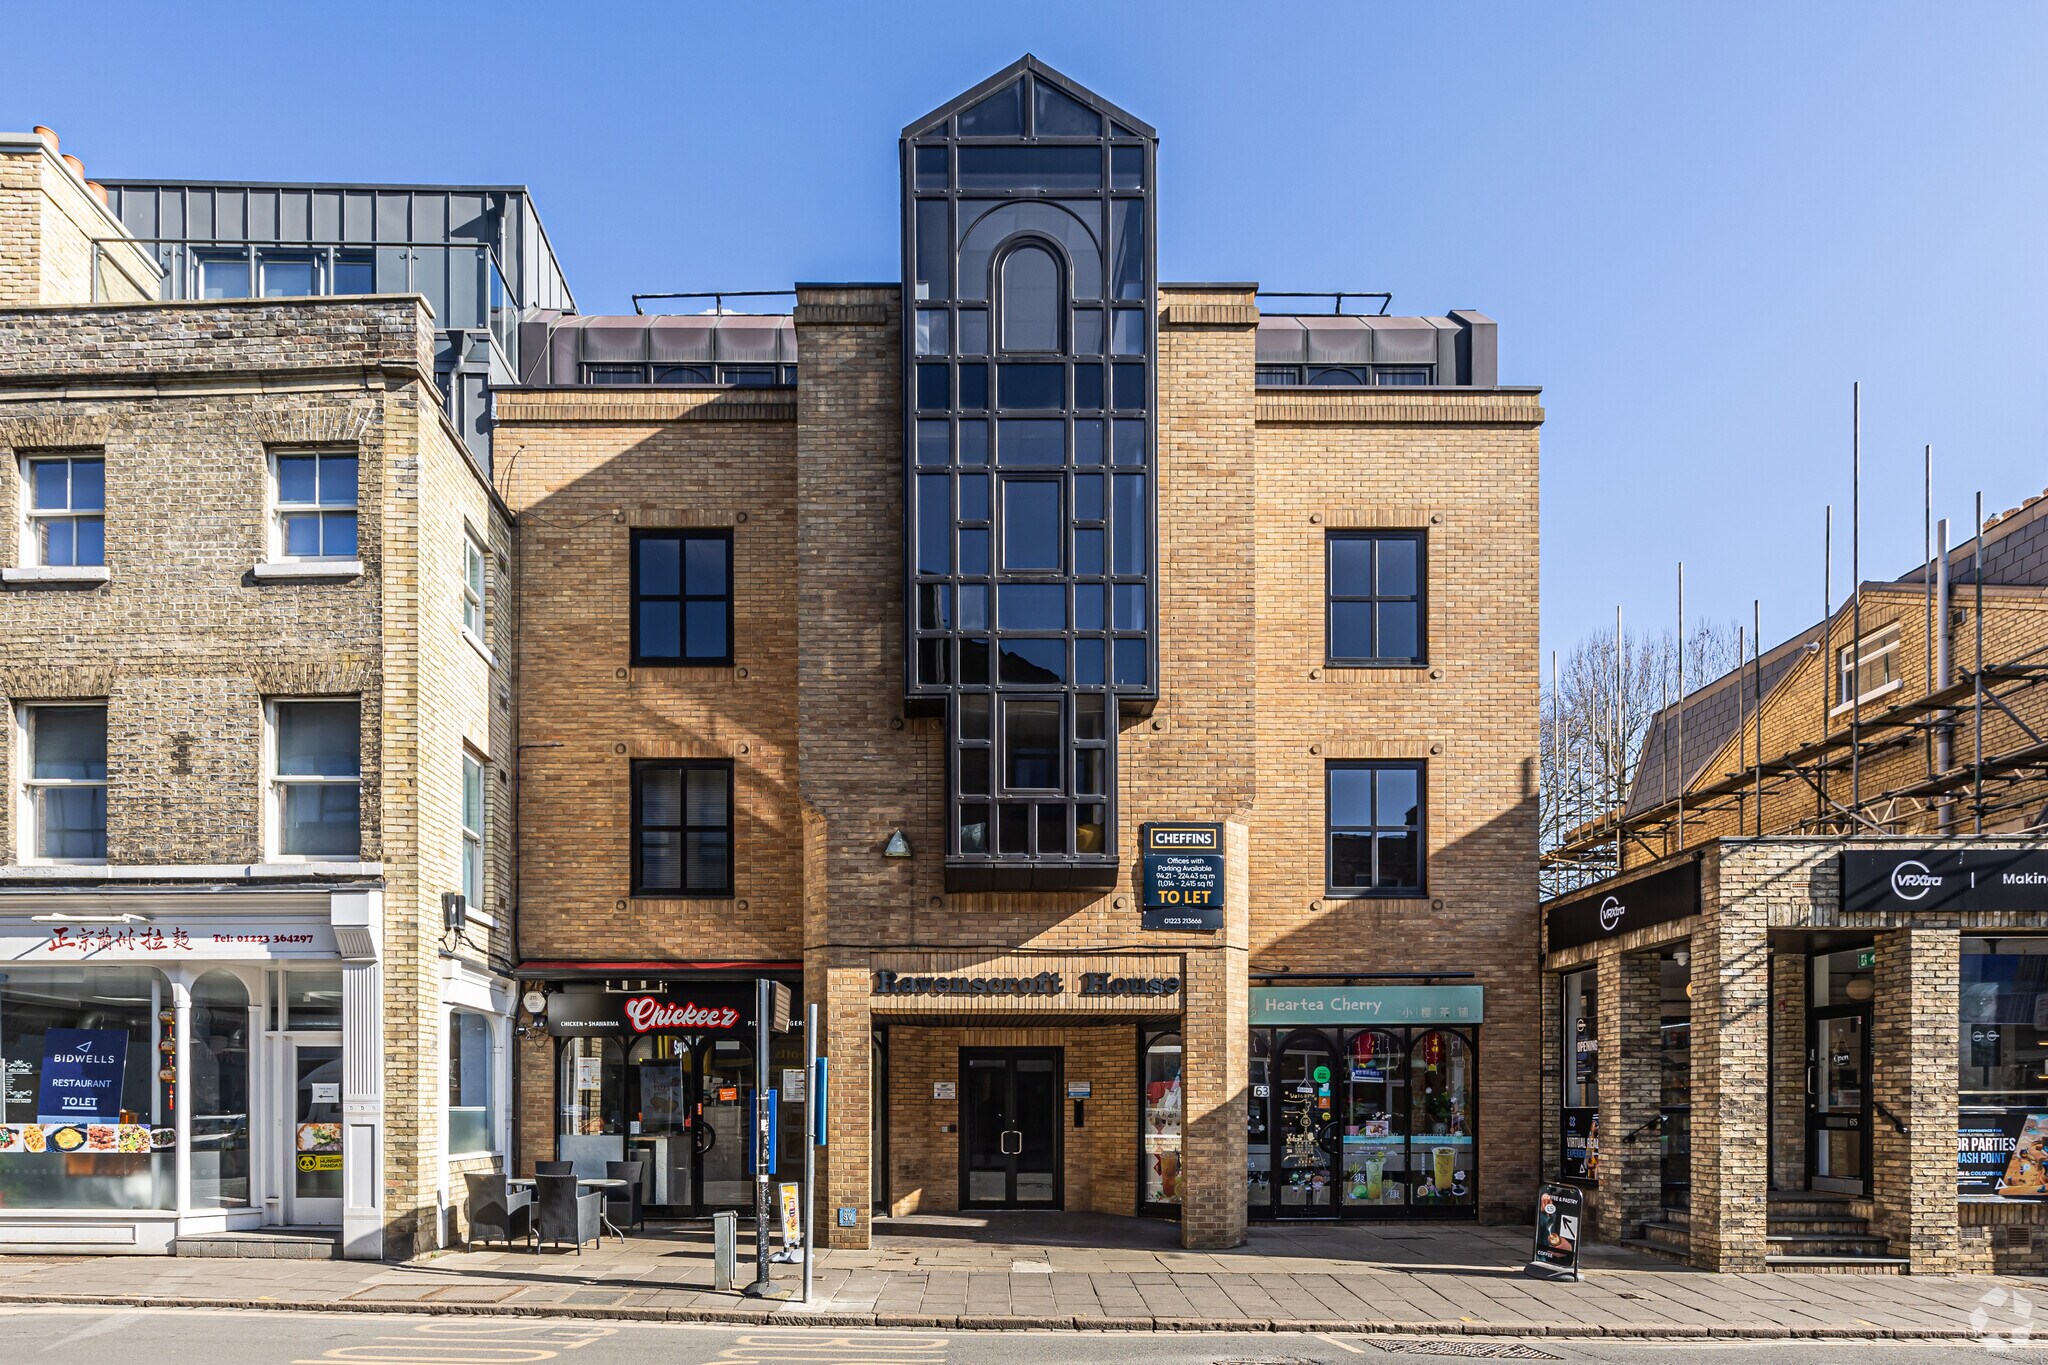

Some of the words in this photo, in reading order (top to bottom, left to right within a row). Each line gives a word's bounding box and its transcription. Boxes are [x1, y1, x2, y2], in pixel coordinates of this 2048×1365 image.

[1155, 833, 1211, 844] CHEFFINS
[1157, 864, 1182, 873] Parking
[1182, 864, 1212, 872] Available
[1156, 872, 1172, 880] 94.21
[1178, 872, 1199, 880] 224.43
[1200, 873, 1208, 881] sq
[1896, 874, 1942, 886] VRXtra
[2002, 872, 2048, 885] Makin
[1198, 881, 1206, 889] sq
[1206, 880, 1214, 888] ft)
[1158, 890, 1180, 904] TO
[1184, 890, 1212, 904] LET
[213, 934, 234, 943] Tel:
[236, 935, 270, 943] 01223
[272, 934, 314, 944] 364297
[876, 971, 1064, 993] Ravenscroft
[1085, 972, 1181, 993] House
[1265, 998, 1324, 1012] Heartea
[1330, 996, 1382, 1015] Cherry
[54, 1054, 115, 1064] BIDWELLS
[52, 1078, 112, 1088] RESTAURANT
[1255, 1087, 1269, 1096] 63
[62, 1096, 78, 1106] TO
[79, 1097, 98, 1106] LET
[1849, 1118, 1858, 1126] 65
[1567, 1136, 1586, 1148] VIRTUAL
[1587, 1137, 1599, 1148] REAL
[1971, 1137, 2016, 1151] PARTIES
[1981, 1152, 2006, 1163] POINT
[1543, 1194, 1558, 1202] COFFEE
[1563, 1197, 1578, 1205] PASTRY
[1537, 1250, 1553, 1259] COFFEE
